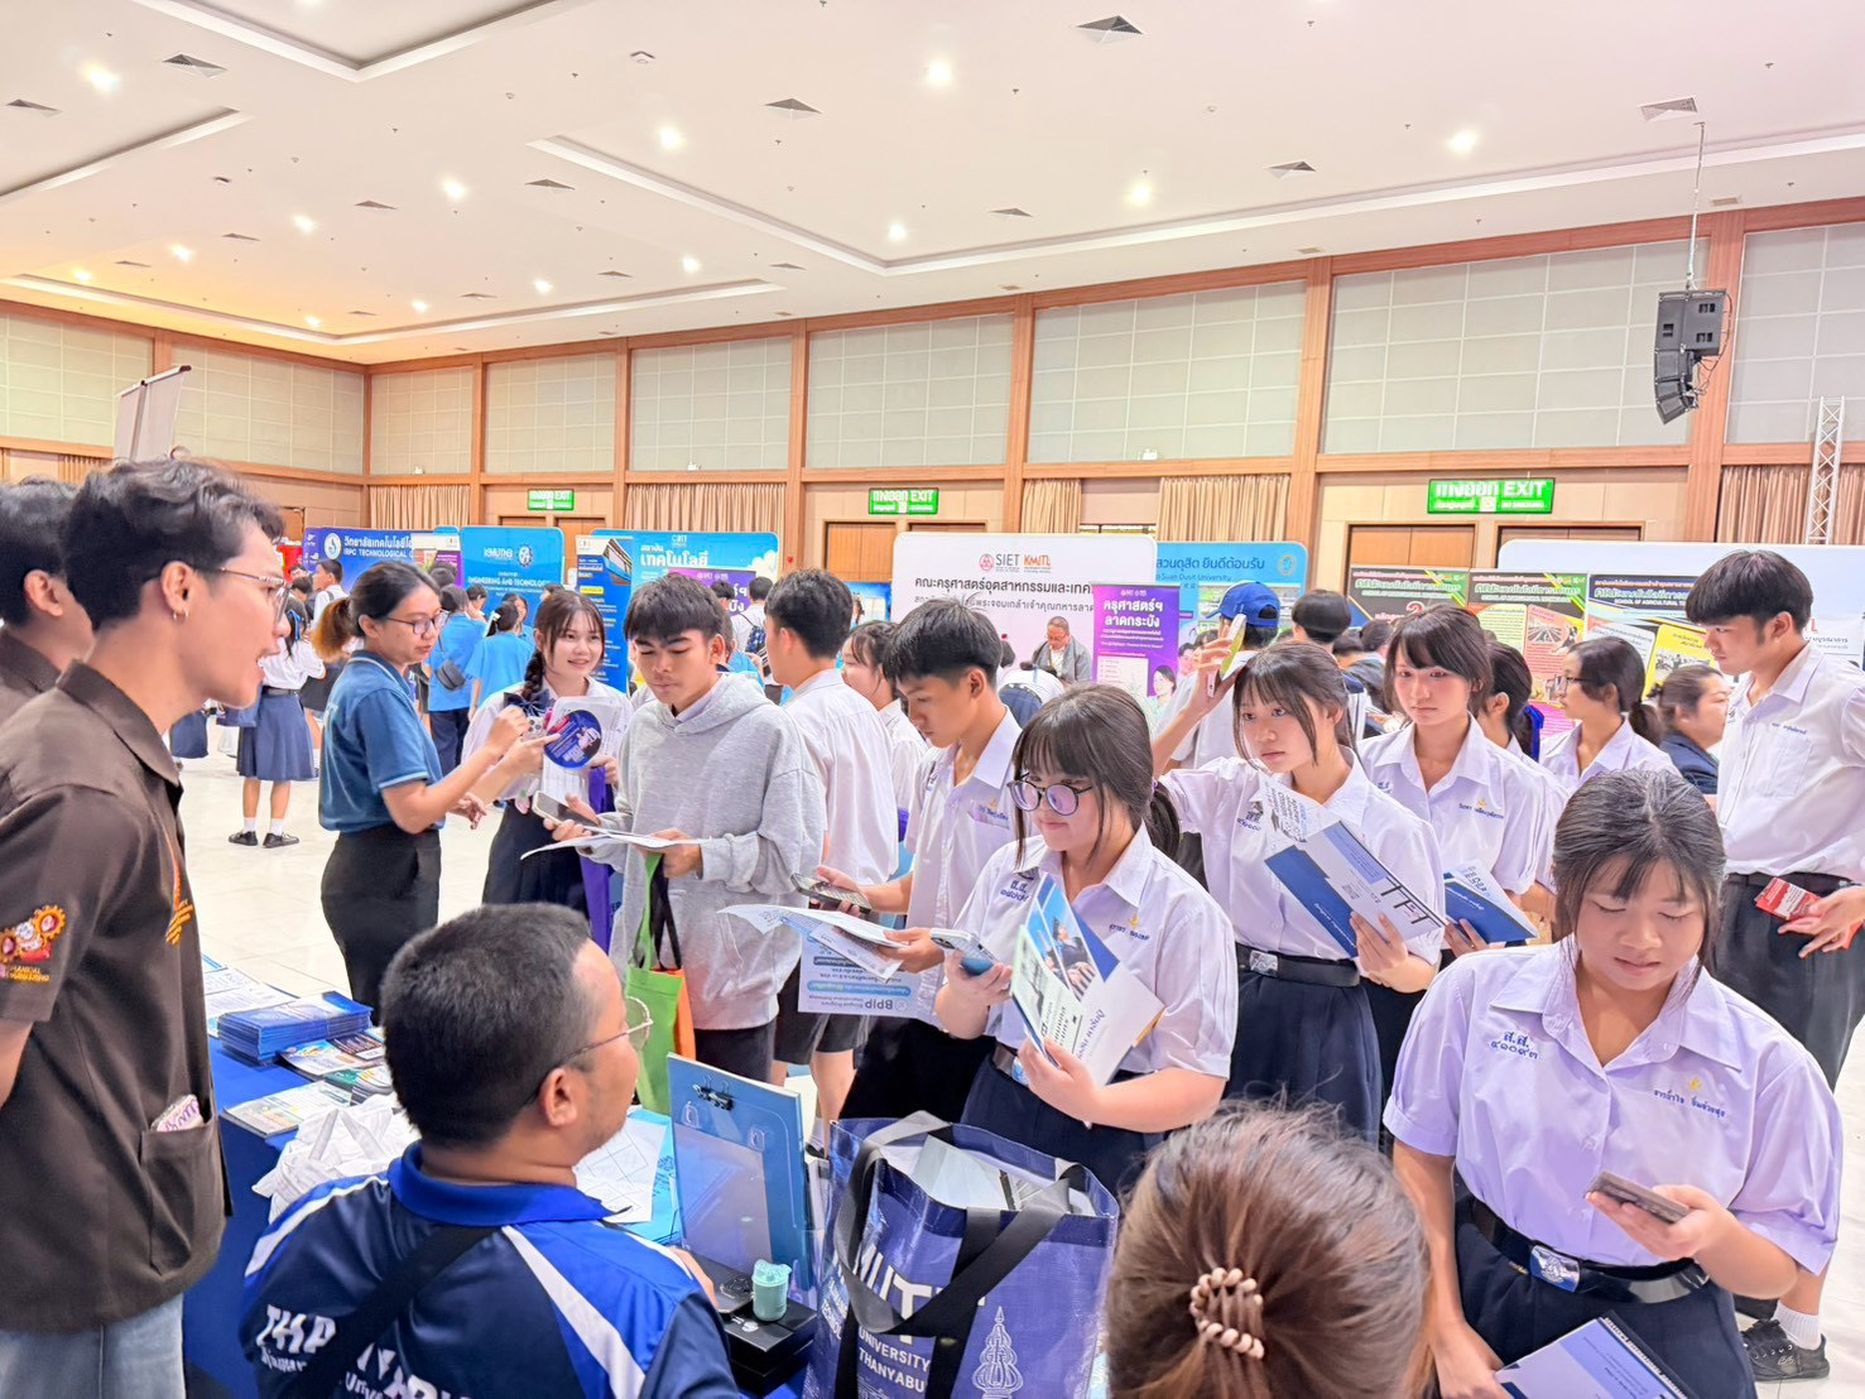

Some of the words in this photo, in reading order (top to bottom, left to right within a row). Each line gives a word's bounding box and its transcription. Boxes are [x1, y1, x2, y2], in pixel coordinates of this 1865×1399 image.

[1503, 480, 1545, 498] EXIT
[640, 550, 708, 568] เทคโนโลยี
[995, 553, 1019, 566] SIET
[915, 577, 1092, 595] คณะครุศาสตร์อุตสาหกรรมและเทค
[1105, 614, 1160, 628] ลาดกระบัง
[858, 1322, 931, 1373] UNIVERSITY
[858, 1346, 926, 1394] THANYABU
